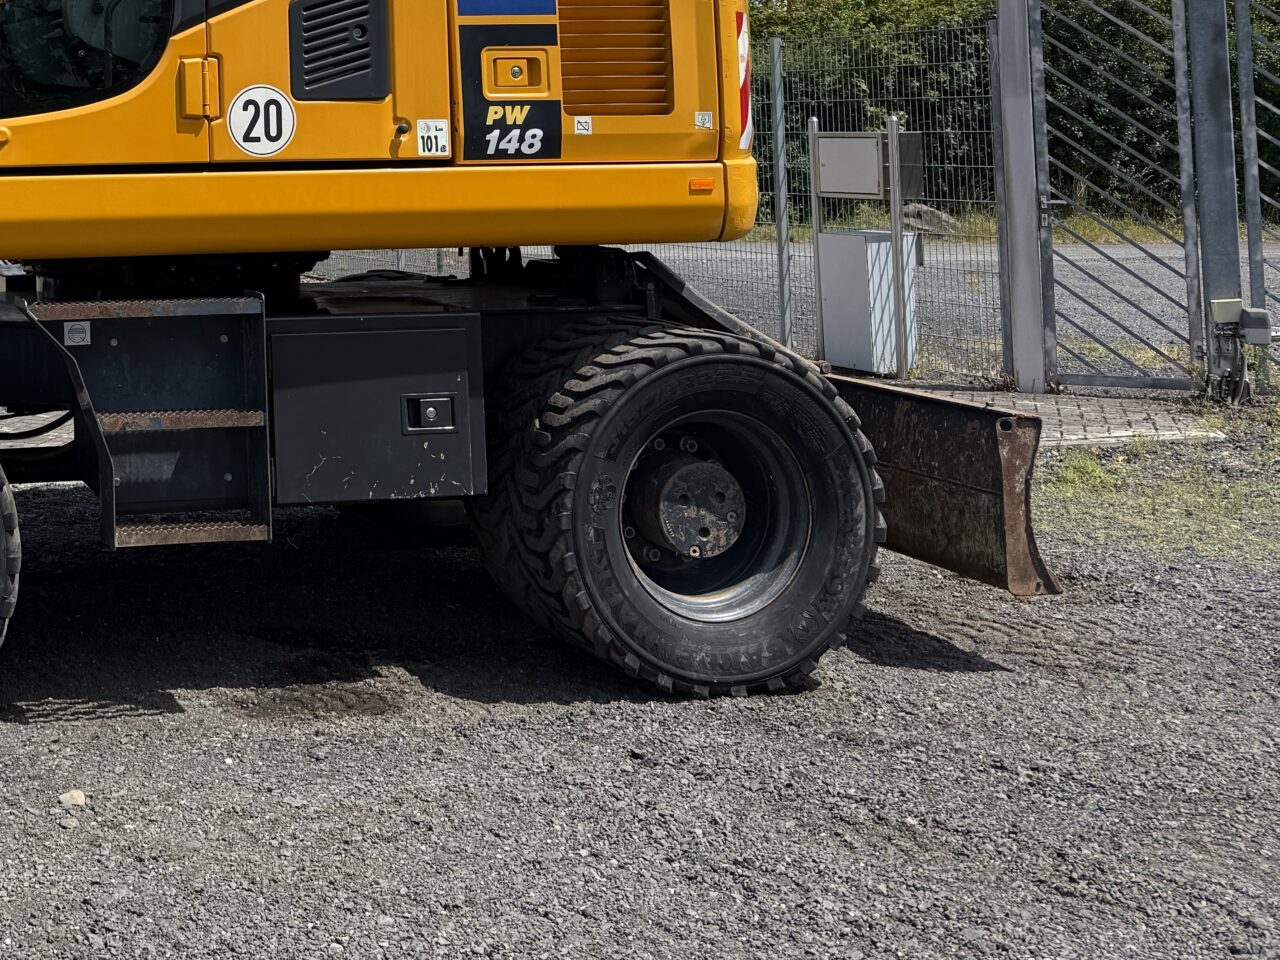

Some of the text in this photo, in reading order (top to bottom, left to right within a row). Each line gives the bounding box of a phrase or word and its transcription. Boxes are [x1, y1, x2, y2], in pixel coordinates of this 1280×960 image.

[241, 98, 283, 143] 20
[485, 105, 531, 125] PW
[420, 135, 439, 152] 101
[485, 128, 544, 155] 148
